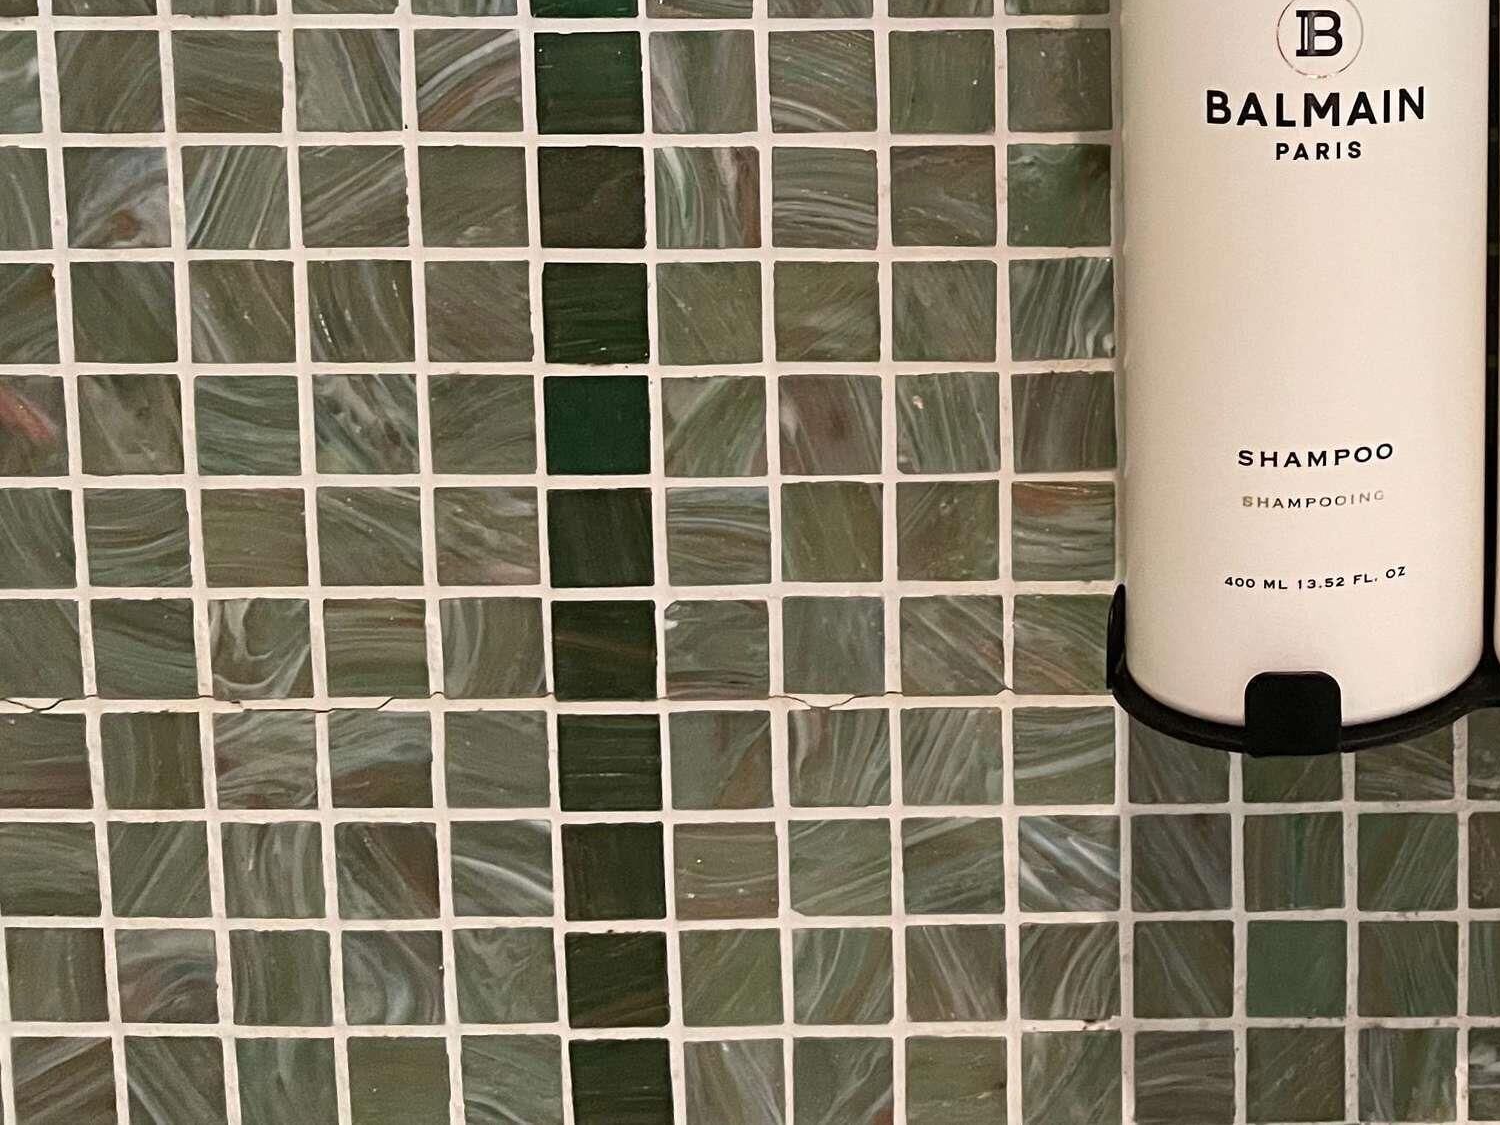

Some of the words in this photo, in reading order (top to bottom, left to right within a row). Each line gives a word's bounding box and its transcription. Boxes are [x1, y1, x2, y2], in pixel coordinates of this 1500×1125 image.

[1295, 9, 1344, 58] B
[1206, 86, 1426, 128] BALMAIN
[1275, 140, 1363, 161] PARIS
[1237, 443, 1394, 468] SHAMPOO
[1242, 489, 1385, 510] SHAMPOOING
[1224, 576, 1256, 589] 400
[1263, 579, 1289, 590] ML
[1297, 576, 1345, 590] 13.52
[1352, 573, 1379, 586] FL.
[1385, 565, 1407, 580] OZ
